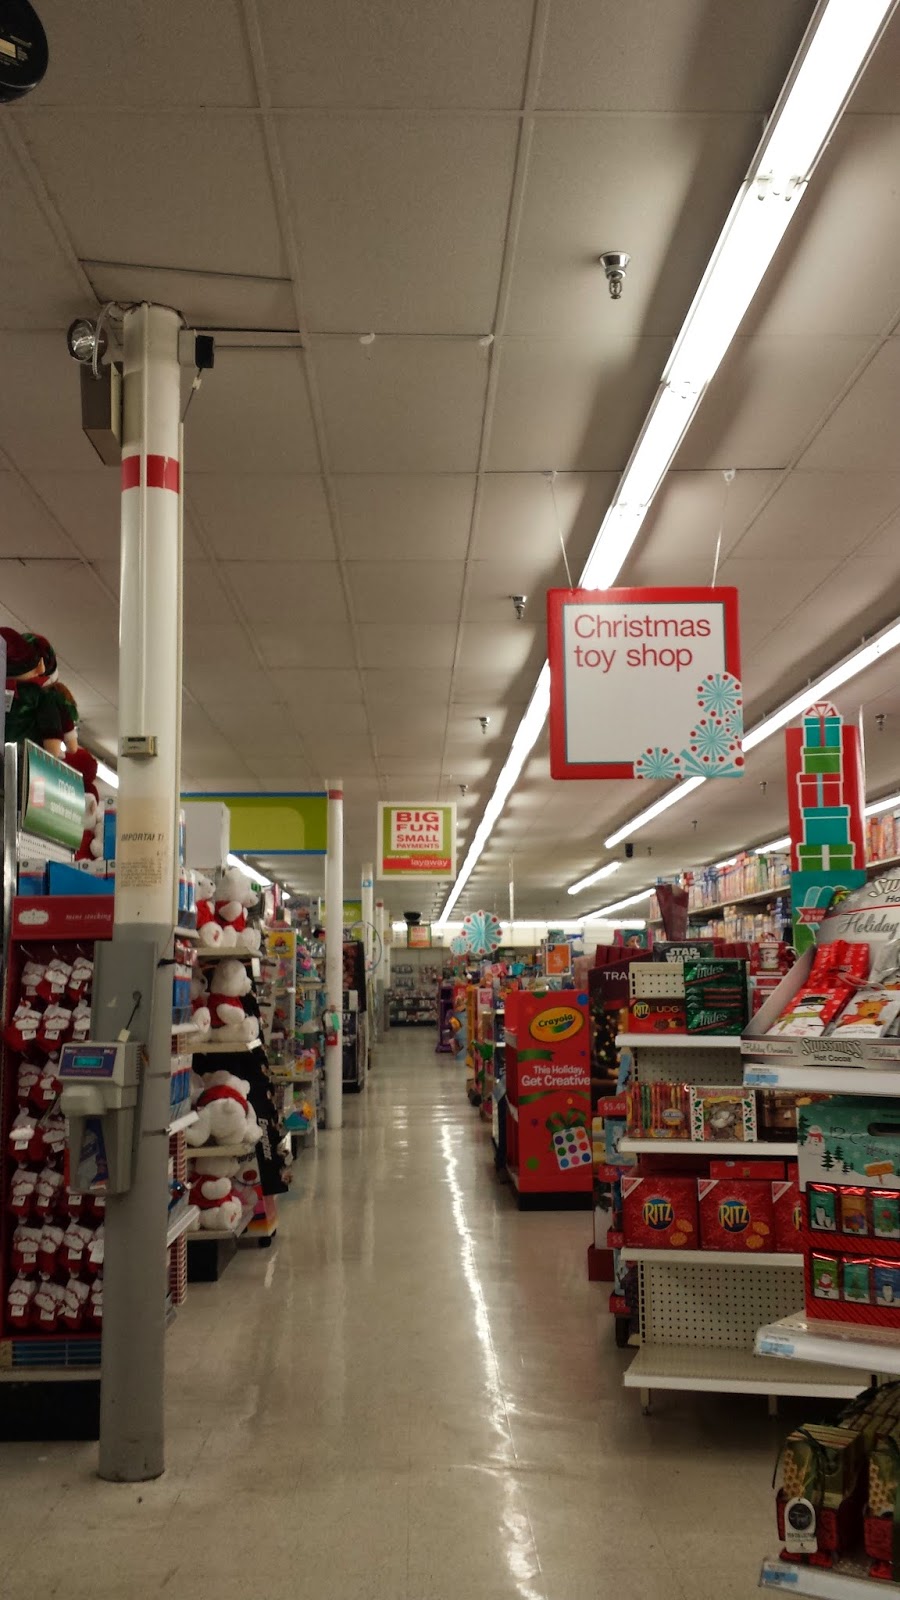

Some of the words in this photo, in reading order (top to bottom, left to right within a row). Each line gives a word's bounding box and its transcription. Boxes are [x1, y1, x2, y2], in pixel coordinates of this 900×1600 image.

[574, 614, 711, 639] Christmas
[573, 645, 616, 674] toy
[626, 643, 693, 672] shop
[396, 811, 439, 823] BIG
[396, 824, 439, 832] FUN
[396, 834, 439, 843] SMALL
[410, 859, 448, 867] layaway
[840, 912, 899, 940] Holiday
[665, 947, 701, 956] STAR
[603, 971, 630, 981] TRA
[634, 1004, 649, 1017] RITZ
[538, 1013, 574, 1028] Crayola
[814, 1053, 828, 1062] Hot
[828, 1054, 852, 1063] Cocoa
[533, 1065, 551, 1074] This
[521, 1075, 542, 1086] Get
[544, 1074, 591, 1086] Creative
[643, 1202, 673, 1226] RITZ
[718, 1204, 749, 1228] RITZ
